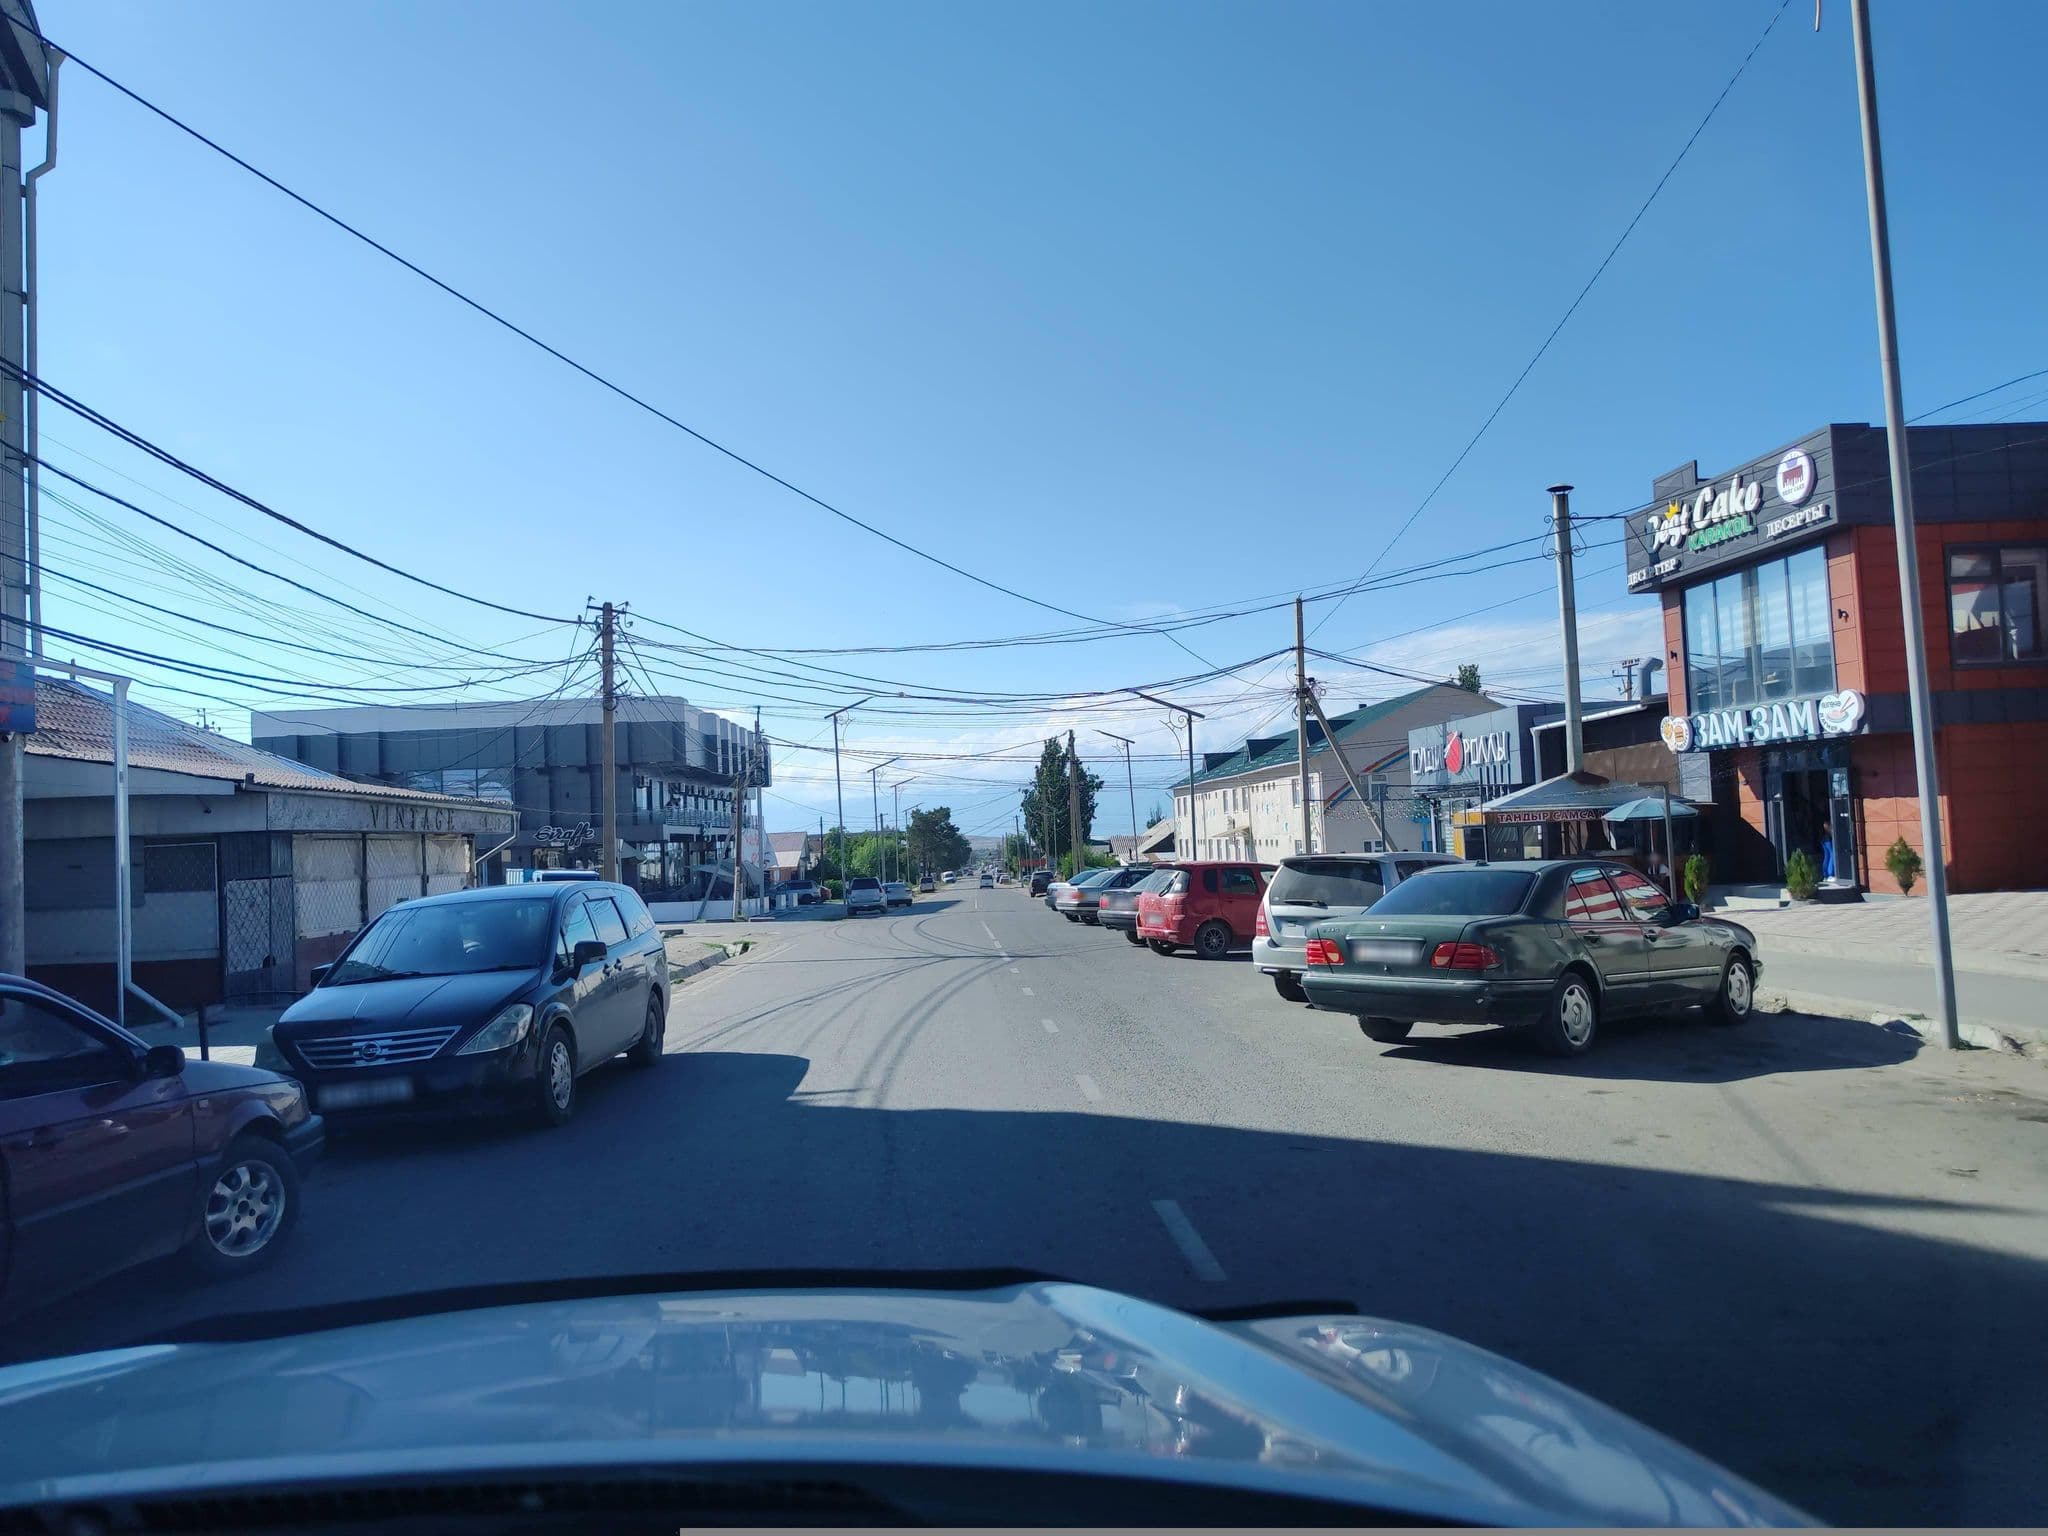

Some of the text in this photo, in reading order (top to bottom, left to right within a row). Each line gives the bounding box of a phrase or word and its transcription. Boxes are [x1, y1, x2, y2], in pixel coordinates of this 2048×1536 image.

[1693, 474, 1762, 527] Cake
[1689, 514, 1755, 551] KARAKOL
[1766, 503, 1828, 538] ДЕСЕРТЫ
[1693, 700, 1816, 747] ЗАМ-ЗАМ
[1462, 730, 1507, 766] РОЛЛЫ
[369, 804, 456, 831] VINTAGE
[1498, 811, 1550, 824] ТАНДЫР
[1553, 809, 1597, 821] САМСА
[532, 821, 595, 848] Giraffe
